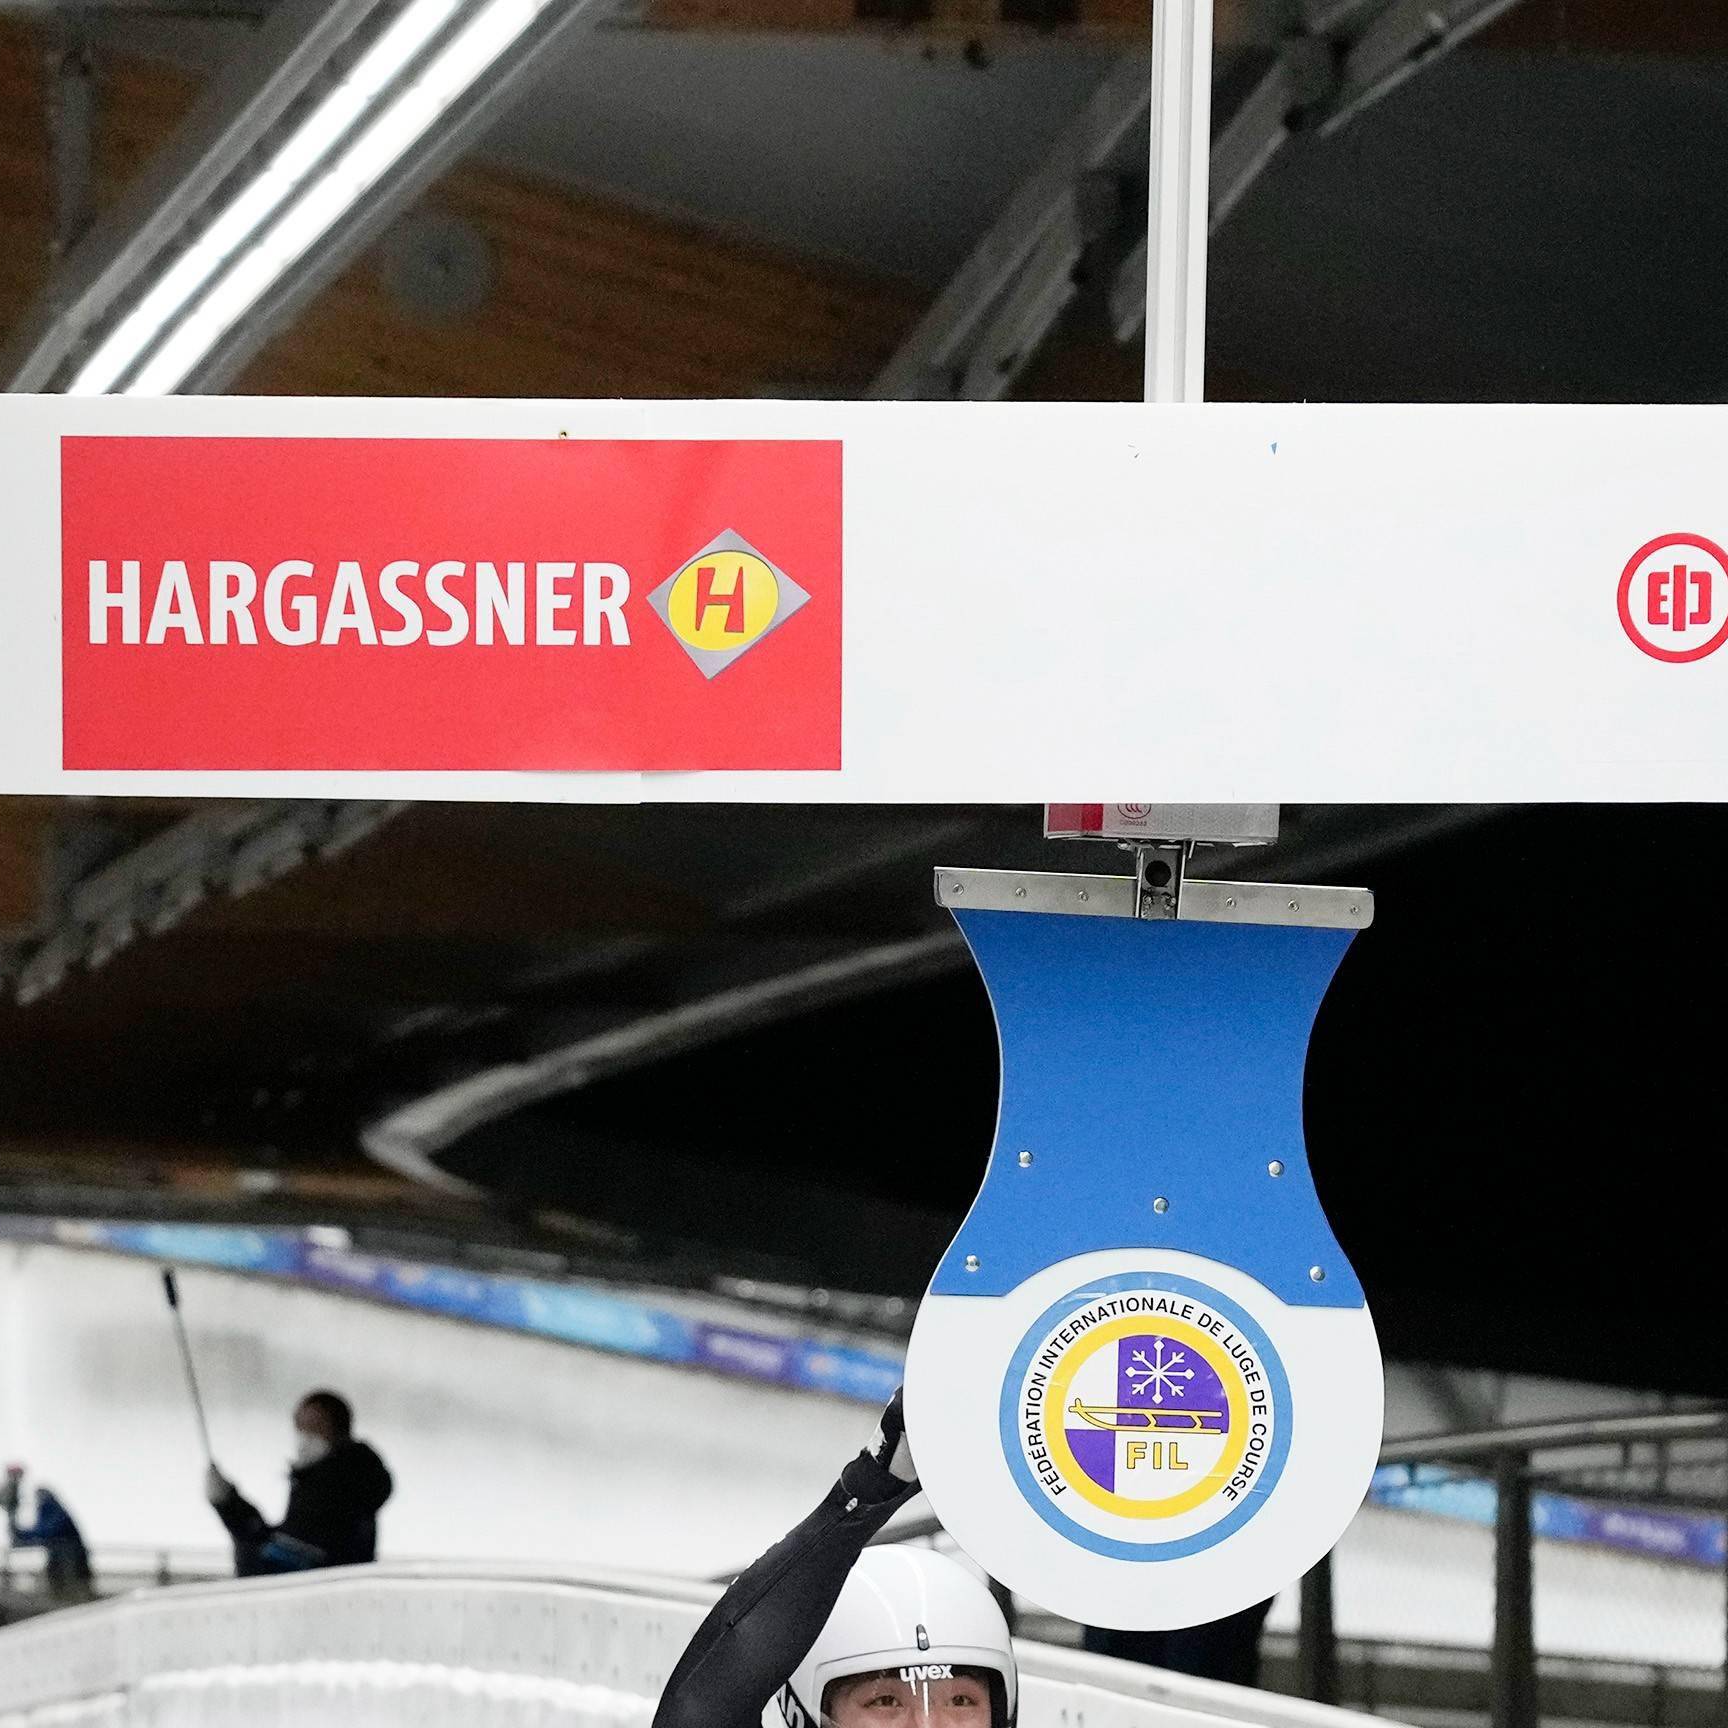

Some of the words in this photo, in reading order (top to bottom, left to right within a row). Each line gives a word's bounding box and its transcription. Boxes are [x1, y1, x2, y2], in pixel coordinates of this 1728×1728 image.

[87, 559, 632, 647] HARGASSNER
[1038, 1296, 1195, 1370] INTERNATIONALE
[1197, 1312, 1225, 1337] DE
[1222, 1334, 1261, 1385] LUGE
[1250, 1388, 1268, 1417] DE
[1025, 1372, 1068, 1497] FÉDÉRATION
[1126, 1440, 1189, 1471] FIL
[1221, 1422, 1268, 1502] COURSE
[899, 1664, 954, 1683] uvex
